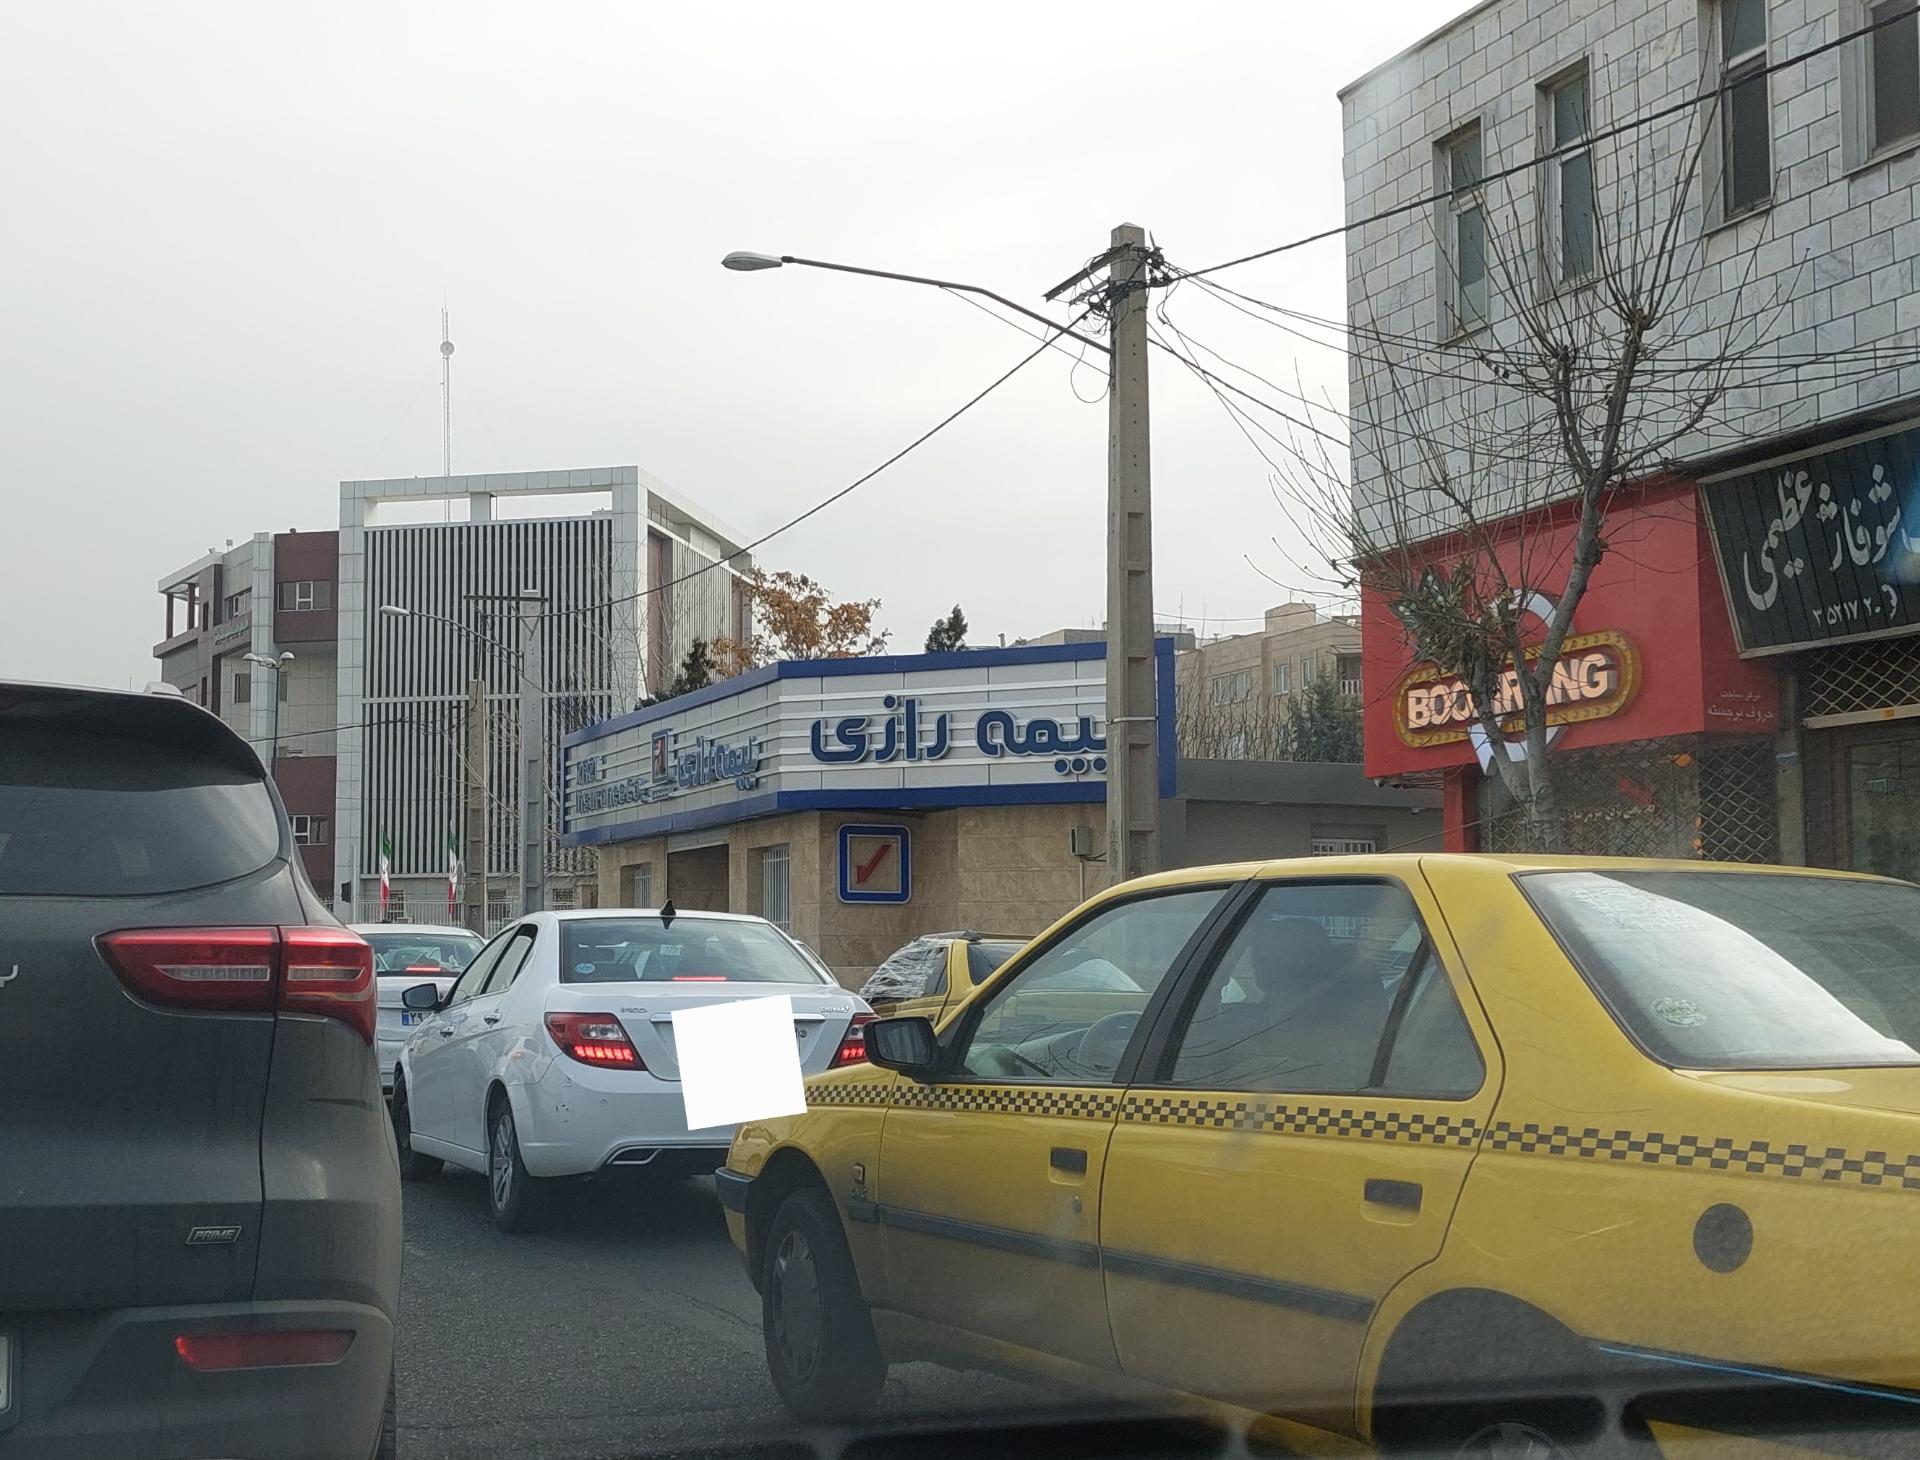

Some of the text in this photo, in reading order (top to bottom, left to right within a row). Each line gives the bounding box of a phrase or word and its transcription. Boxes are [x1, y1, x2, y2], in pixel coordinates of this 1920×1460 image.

[1743, 470, 1813, 611] عظیمی
[809, 694, 949, 763] رازی
[193, 1229, 236, 1241] PRIME
